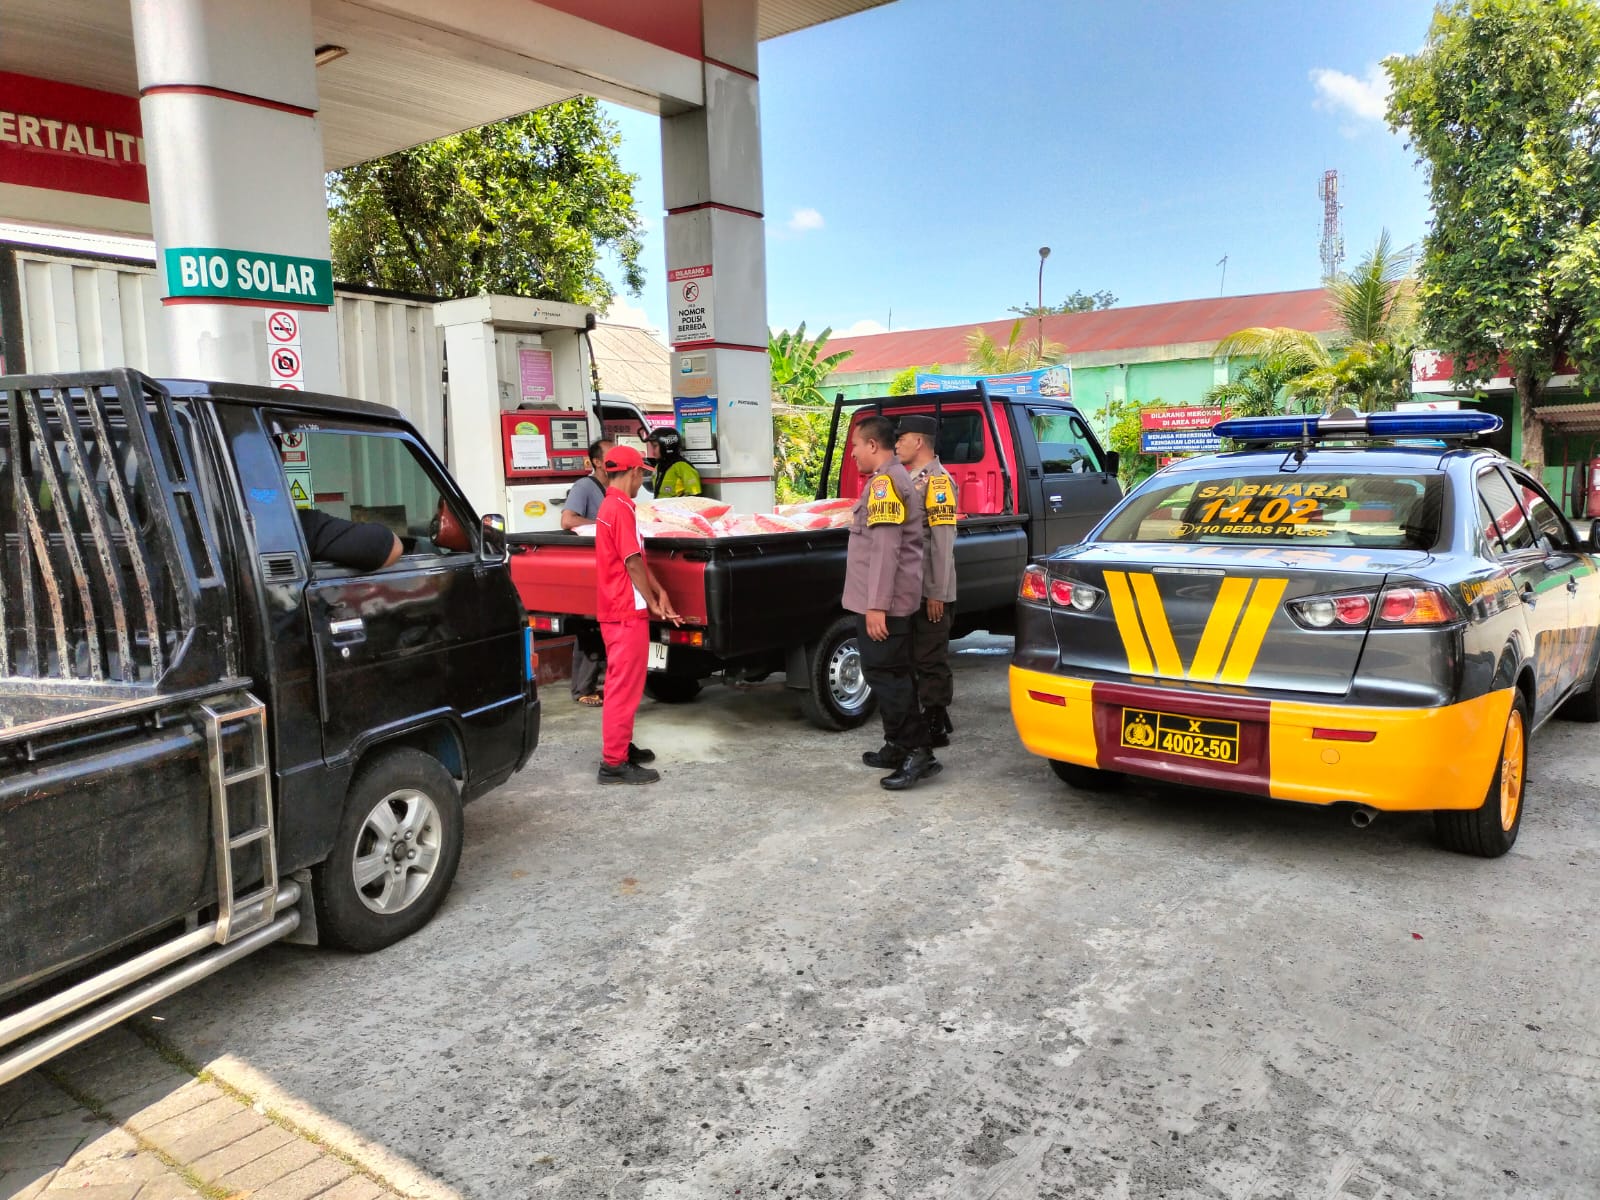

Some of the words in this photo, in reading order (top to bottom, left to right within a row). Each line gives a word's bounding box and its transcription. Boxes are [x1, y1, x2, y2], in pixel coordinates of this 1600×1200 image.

[179, 255, 229, 288] BIO
[236, 258, 317, 296] SOLAR
[675, 267, 705, 277] DILARANG
[678, 307, 705, 317] NOMOR
[681, 315, 703, 324] POLISI
[678, 323, 707, 332] BERBEDA
[1151, 411, 1185, 419] DILARANG
[1186, 409, 1222, 417] MEROKOK
[1175, 431, 1212, 439] KEBERSIHAN
[1199, 484, 1349, 499] SABHARA
[1200, 497, 1319, 524] 14.02
[1194, 525, 1220, 534] 110
[1221, 525, 1273, 535] BEBAS
[1276, 526, 1330, 537] PULSA
[1188, 720, 1201, 733] X
[1162, 732, 1231, 760] 4002-50
